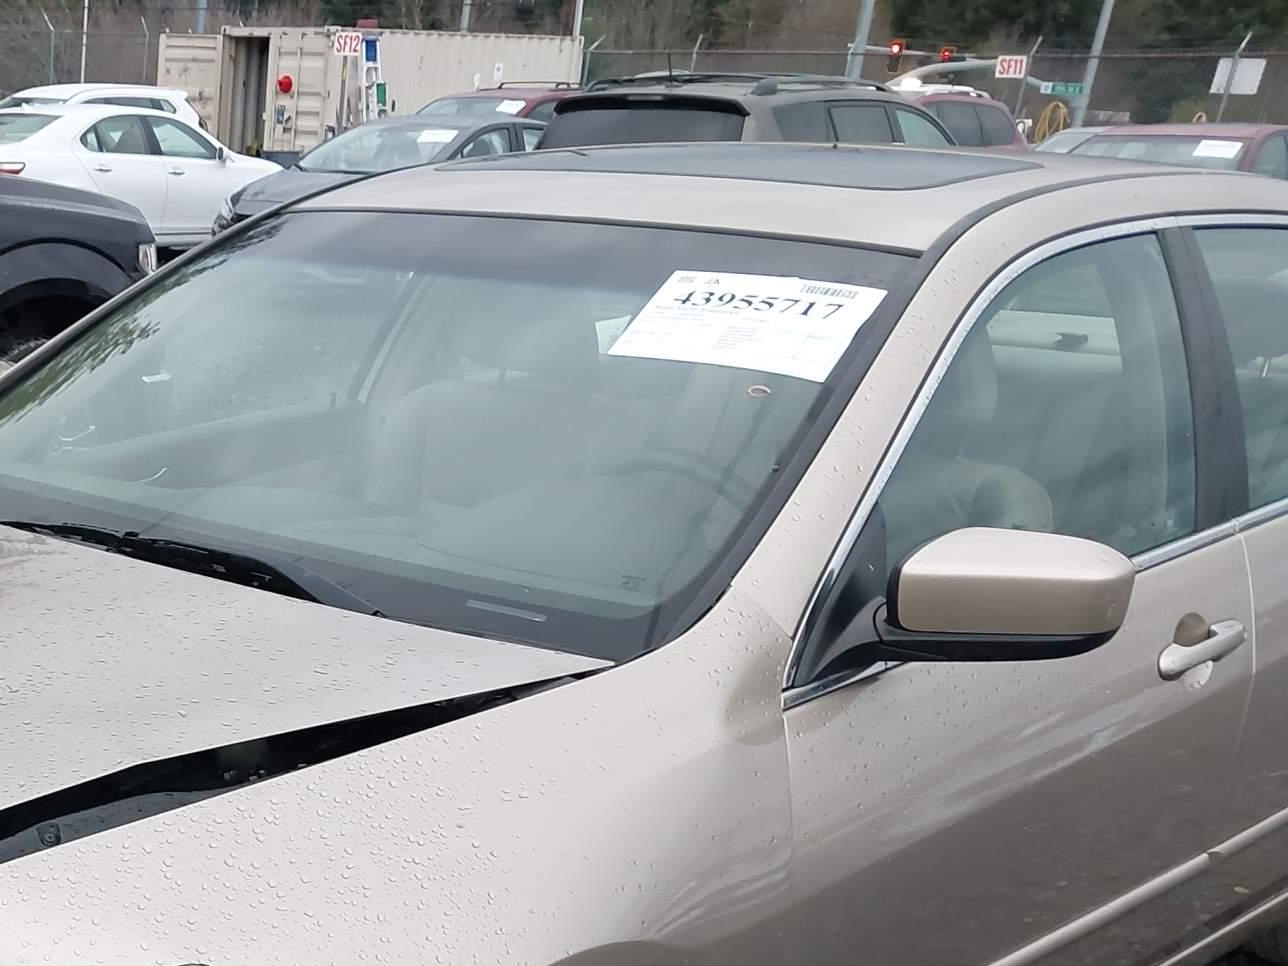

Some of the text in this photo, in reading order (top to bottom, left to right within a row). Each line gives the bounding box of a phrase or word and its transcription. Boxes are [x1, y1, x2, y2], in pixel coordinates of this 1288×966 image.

[336, 34, 360, 53] SF12
[999, 58, 1024, 75] SF11
[673, 290, 844, 320] 43955717
